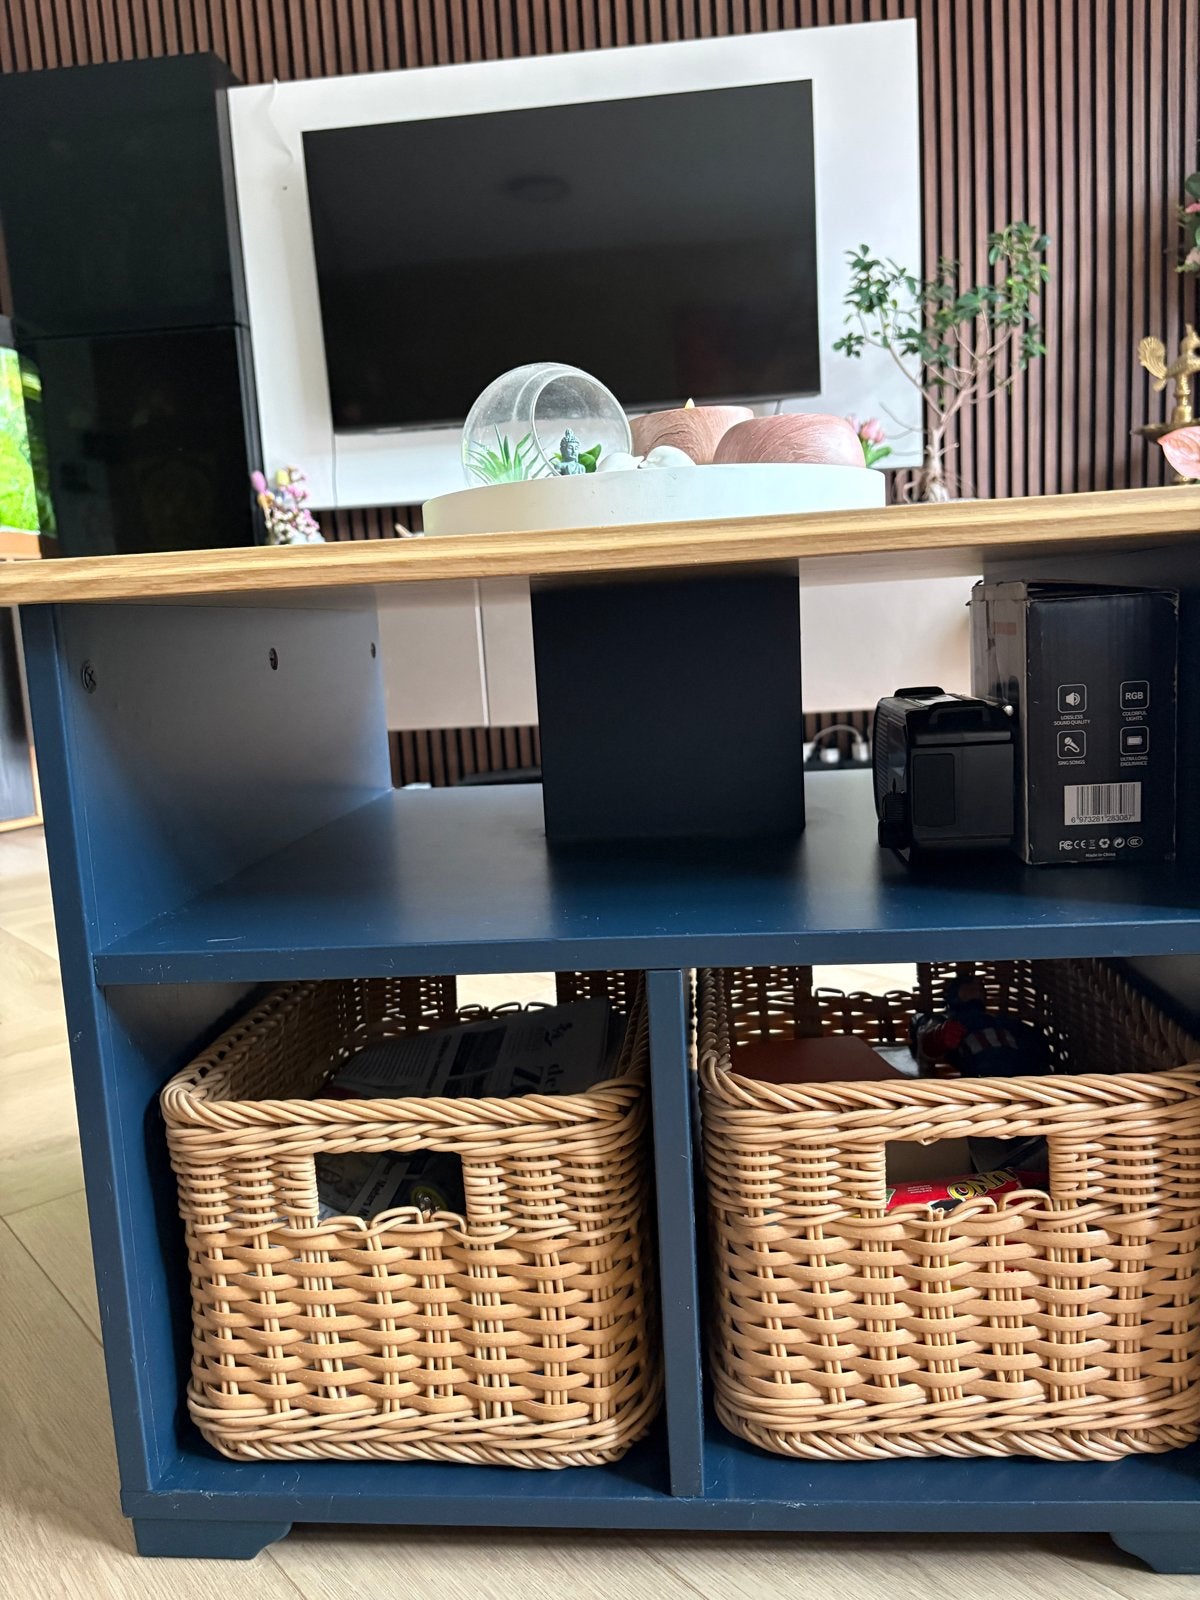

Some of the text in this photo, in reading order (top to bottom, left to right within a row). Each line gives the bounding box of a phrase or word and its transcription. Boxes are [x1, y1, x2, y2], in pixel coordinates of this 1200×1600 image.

[1125, 691, 1144, 700] RGB
[1078, 815, 1104, 823] 973281
[1106, 814, 1132, 822] 283087
[947, 1167, 1018, 1200] UNO
